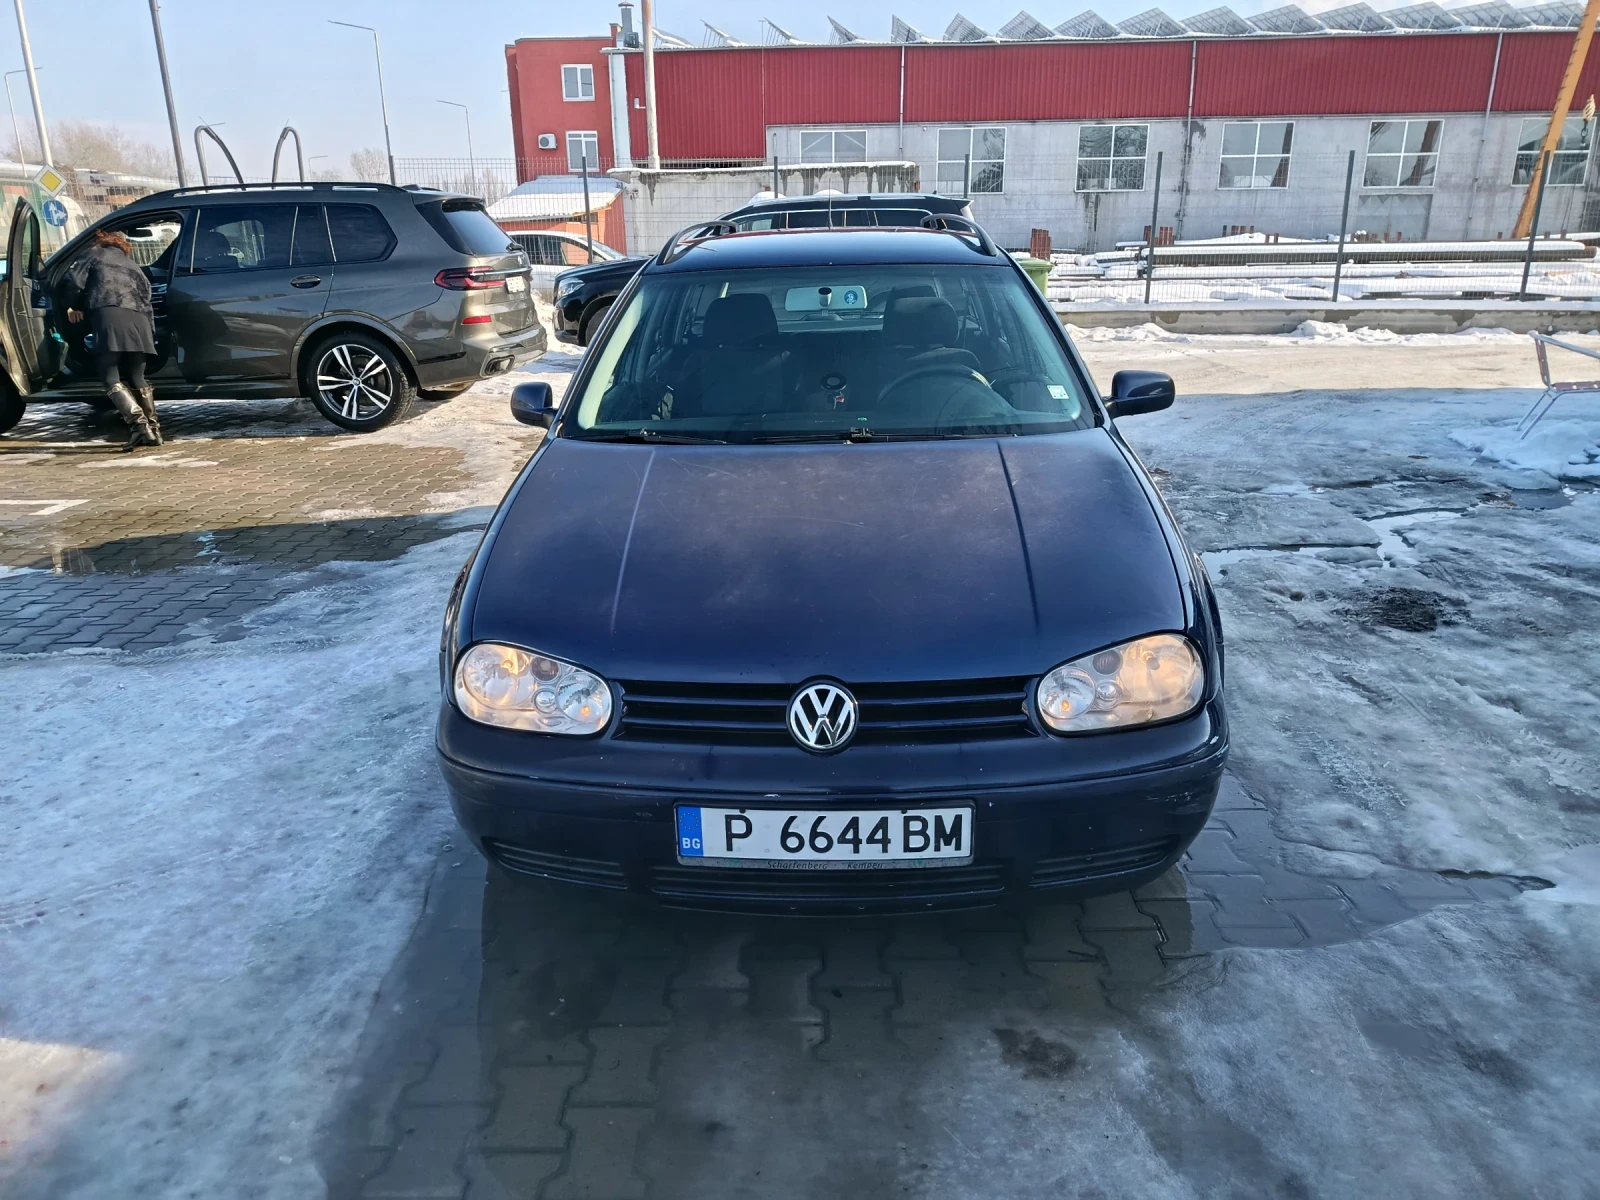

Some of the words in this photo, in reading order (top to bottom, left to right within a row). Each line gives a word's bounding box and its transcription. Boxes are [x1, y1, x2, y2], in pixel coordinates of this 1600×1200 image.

[724, 814, 753, 852] P
[780, 815, 891, 854] 6644
[903, 814, 963, 853] BM
[682, 837, 701, 849] BG
[847, 861, 884, 870] Kempen
